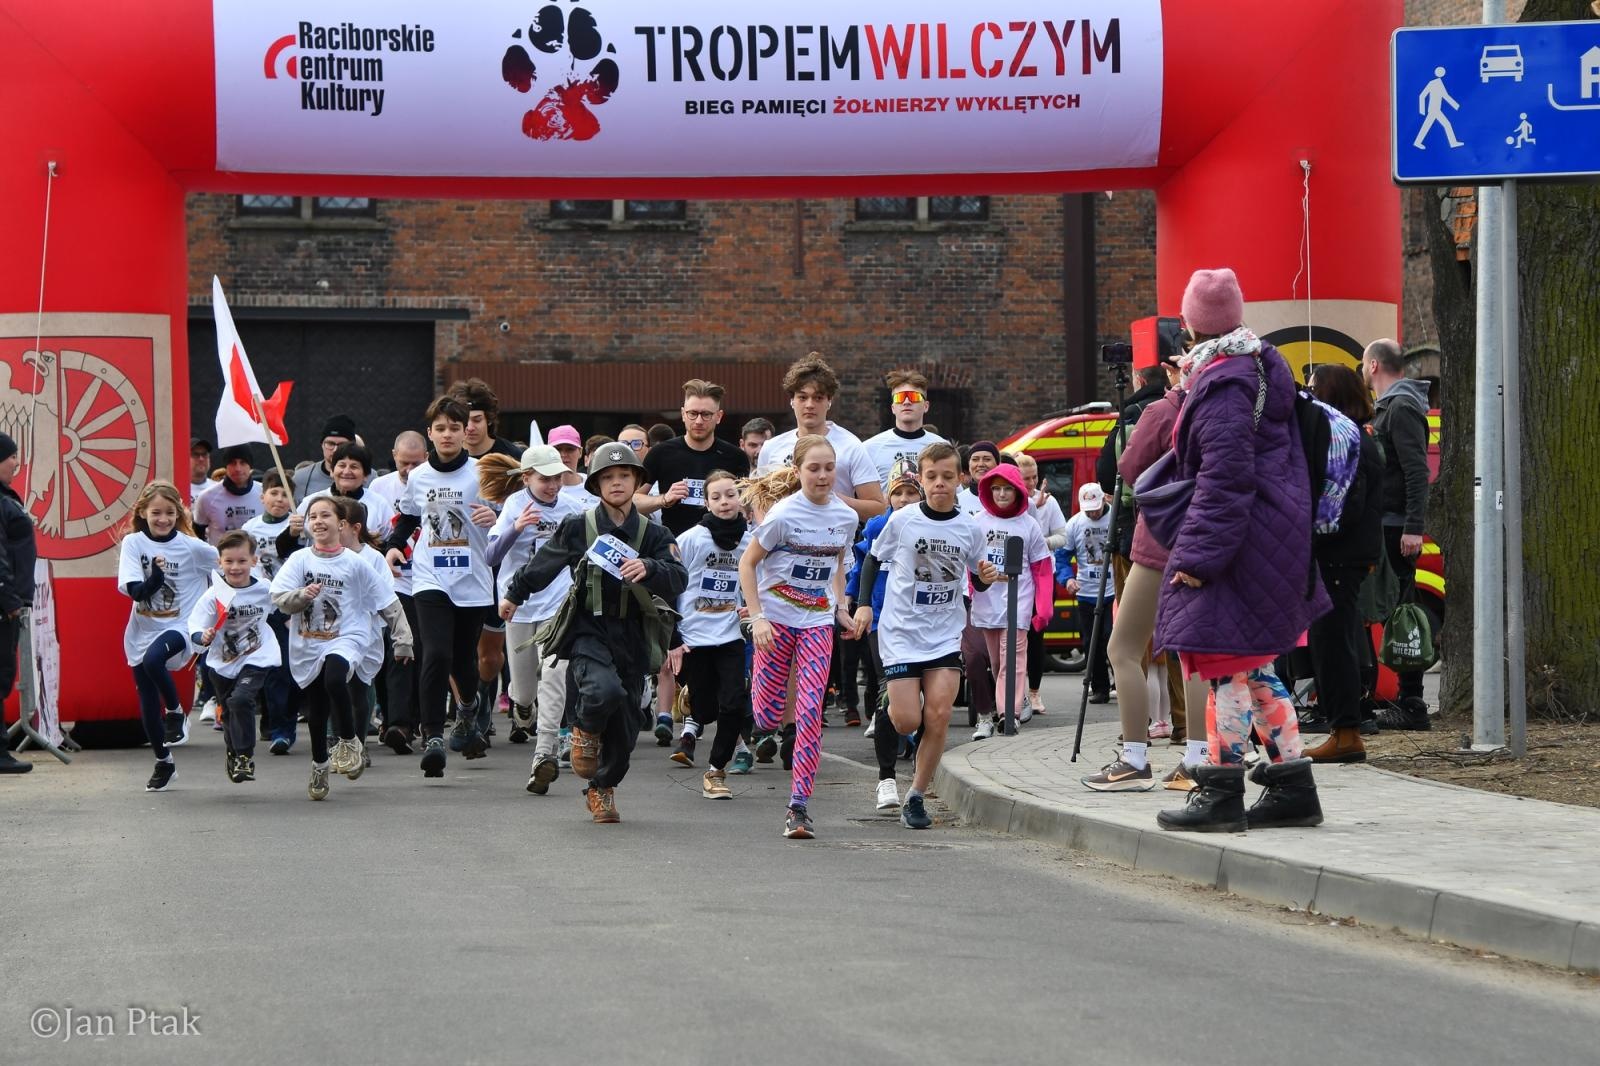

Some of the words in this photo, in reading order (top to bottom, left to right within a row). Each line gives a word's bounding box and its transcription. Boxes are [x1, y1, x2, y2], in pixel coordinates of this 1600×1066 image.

[298, 21, 435, 53] Raciborskie
[300, 54, 384, 83] entrum
[300, 80, 385, 117] Kultury
[684, 100, 735, 116] BIEG
[741, 99, 827, 118] PAMIĘCI
[832, 94, 950, 115] ŻOŁNIERZY
[956, 93, 1081, 113] WYKLĘTYCH
[930, 543, 961, 554] WILCZYM
[445, 556, 459, 567] 11
[604, 548, 622, 565] 48
[991, 555, 1004, 565] 10
[804, 568, 821, 580] 51
[713, 580, 729, 592] 89
[926, 592, 949, 605] 129
